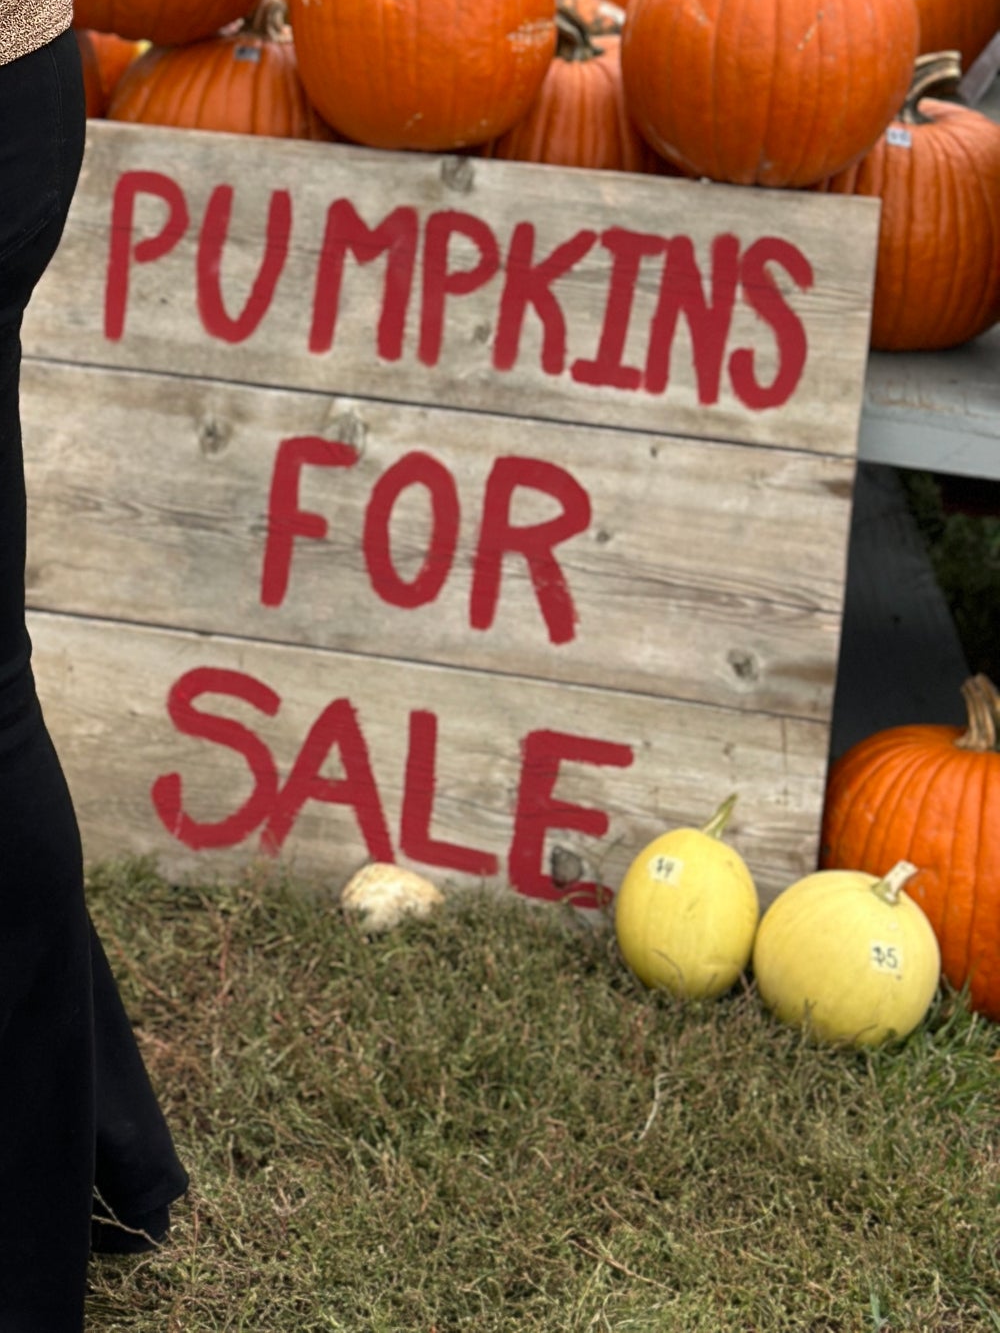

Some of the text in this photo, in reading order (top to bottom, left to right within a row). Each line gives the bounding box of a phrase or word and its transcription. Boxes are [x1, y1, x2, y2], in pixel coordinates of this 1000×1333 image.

[104, 171, 814, 410] PUMPKINS
[260, 435, 592, 646] FOR
[151, 666, 634, 909] SALE
[871, 945, 898, 969] $5
